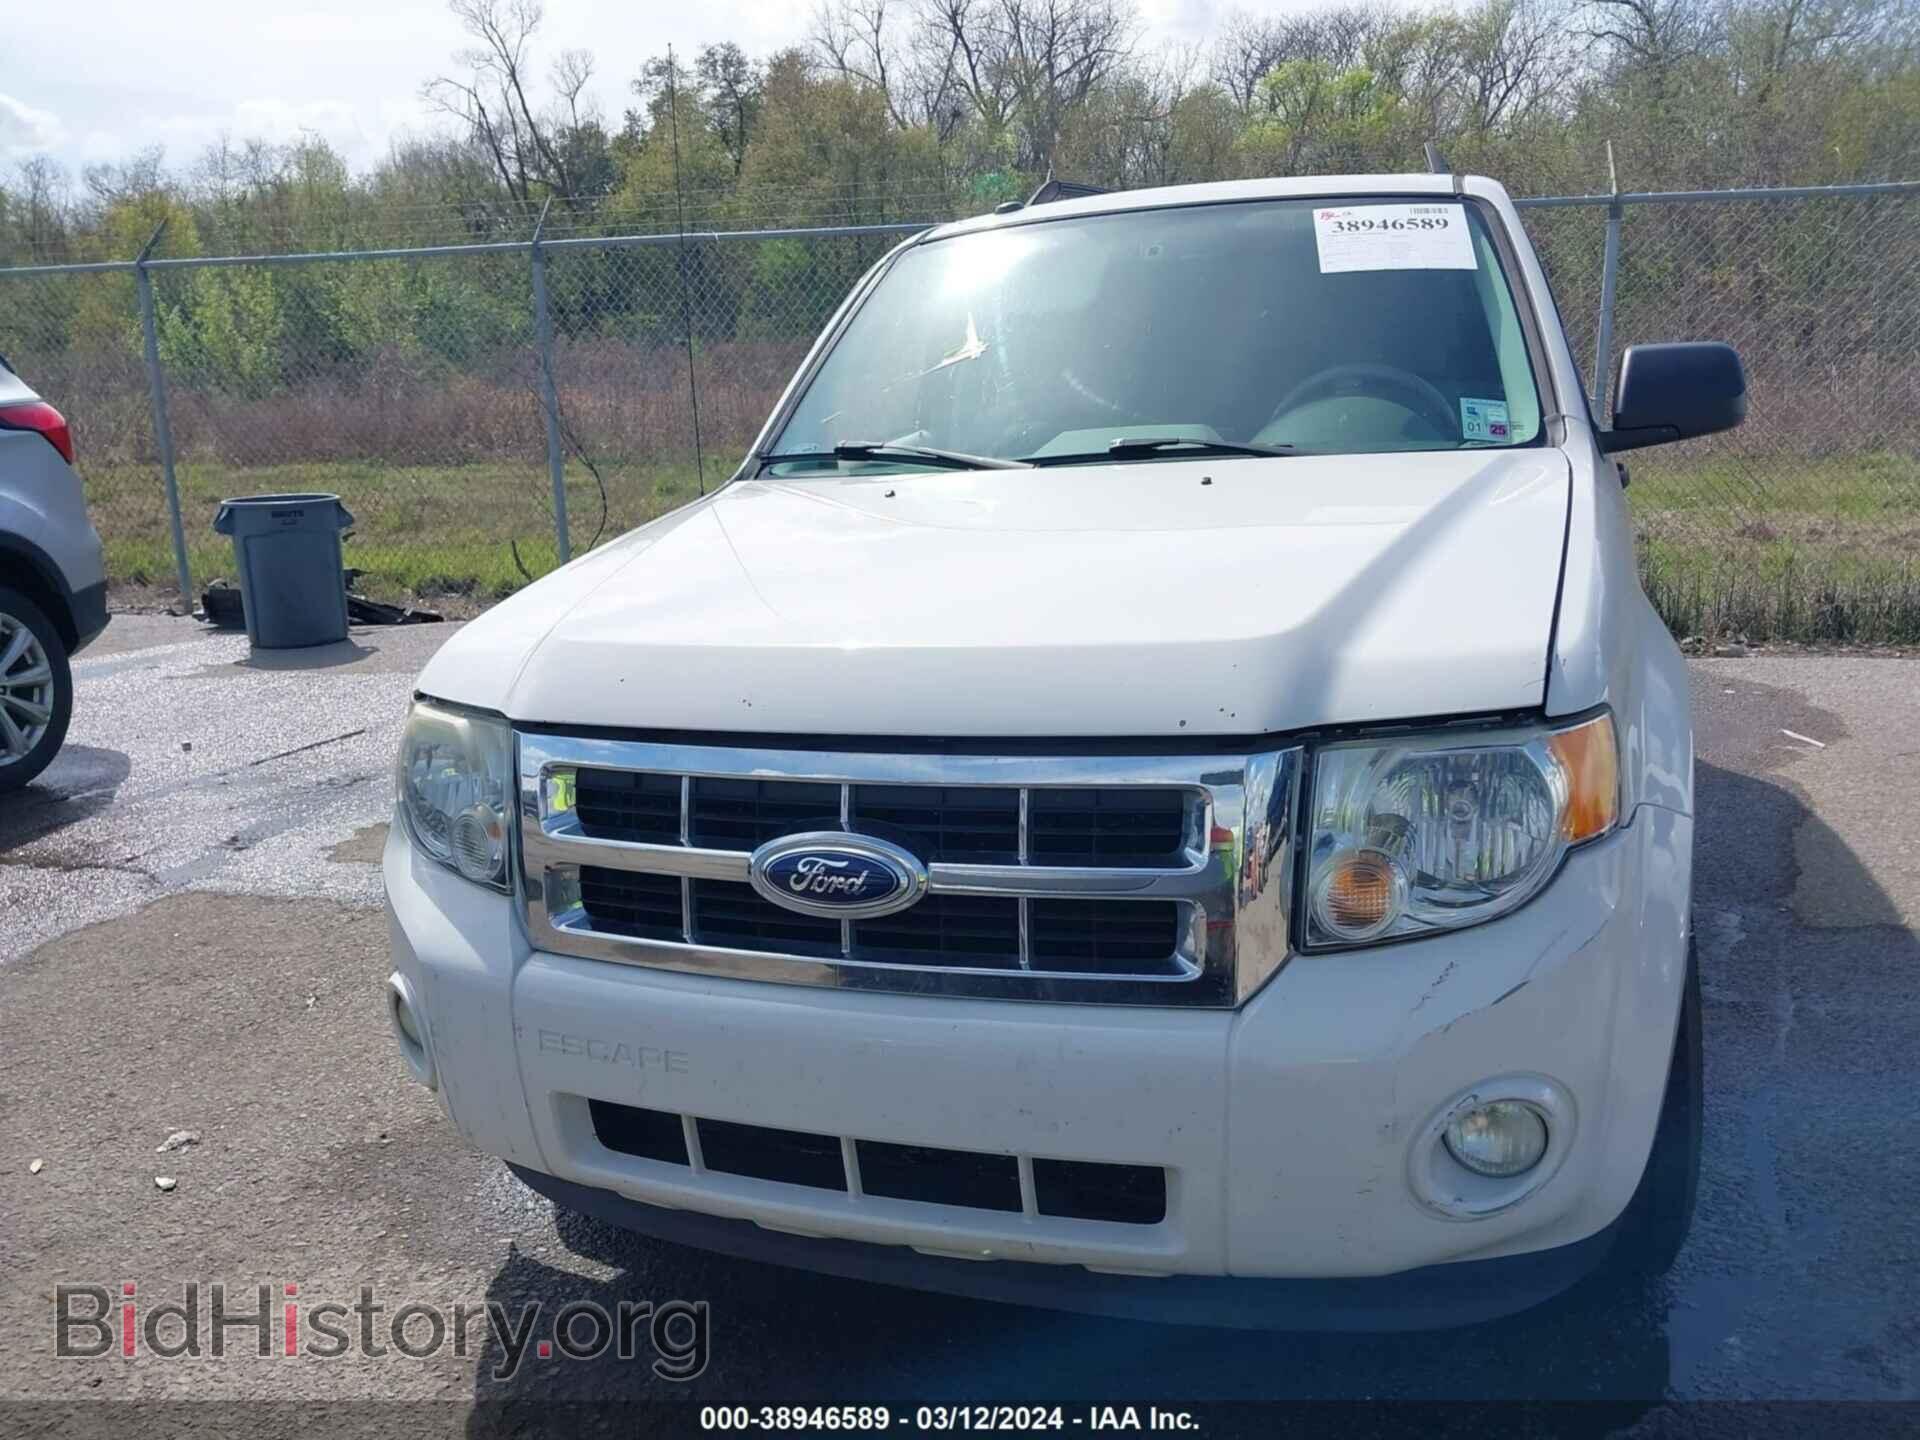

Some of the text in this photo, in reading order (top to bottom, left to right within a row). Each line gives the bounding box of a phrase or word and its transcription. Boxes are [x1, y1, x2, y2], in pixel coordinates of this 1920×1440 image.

[1331, 218, 1449, 234] 38946589
[789, 856, 870, 895] Ford
[538, 1028, 688, 1073] ESCAPE
